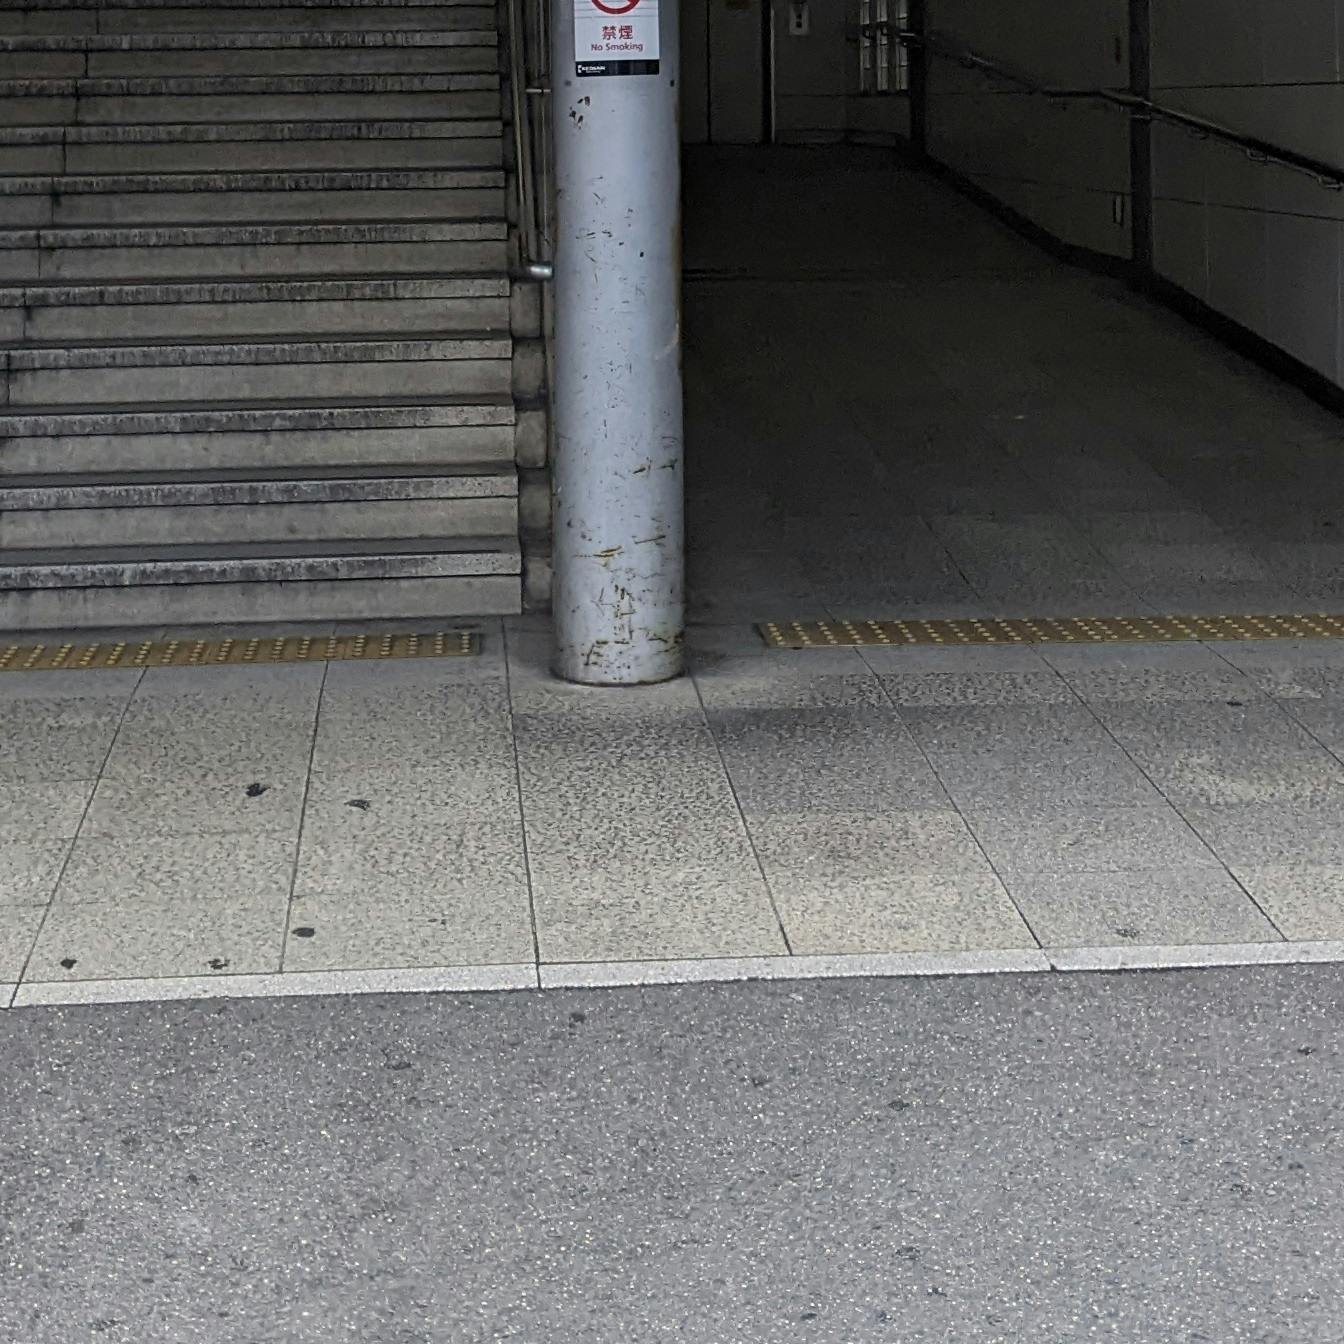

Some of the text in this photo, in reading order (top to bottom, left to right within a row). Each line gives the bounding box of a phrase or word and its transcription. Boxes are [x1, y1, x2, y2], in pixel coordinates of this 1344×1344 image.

[601, 25, 633, 40] 禁煙
[591, 42, 643, 53] No Smoking
